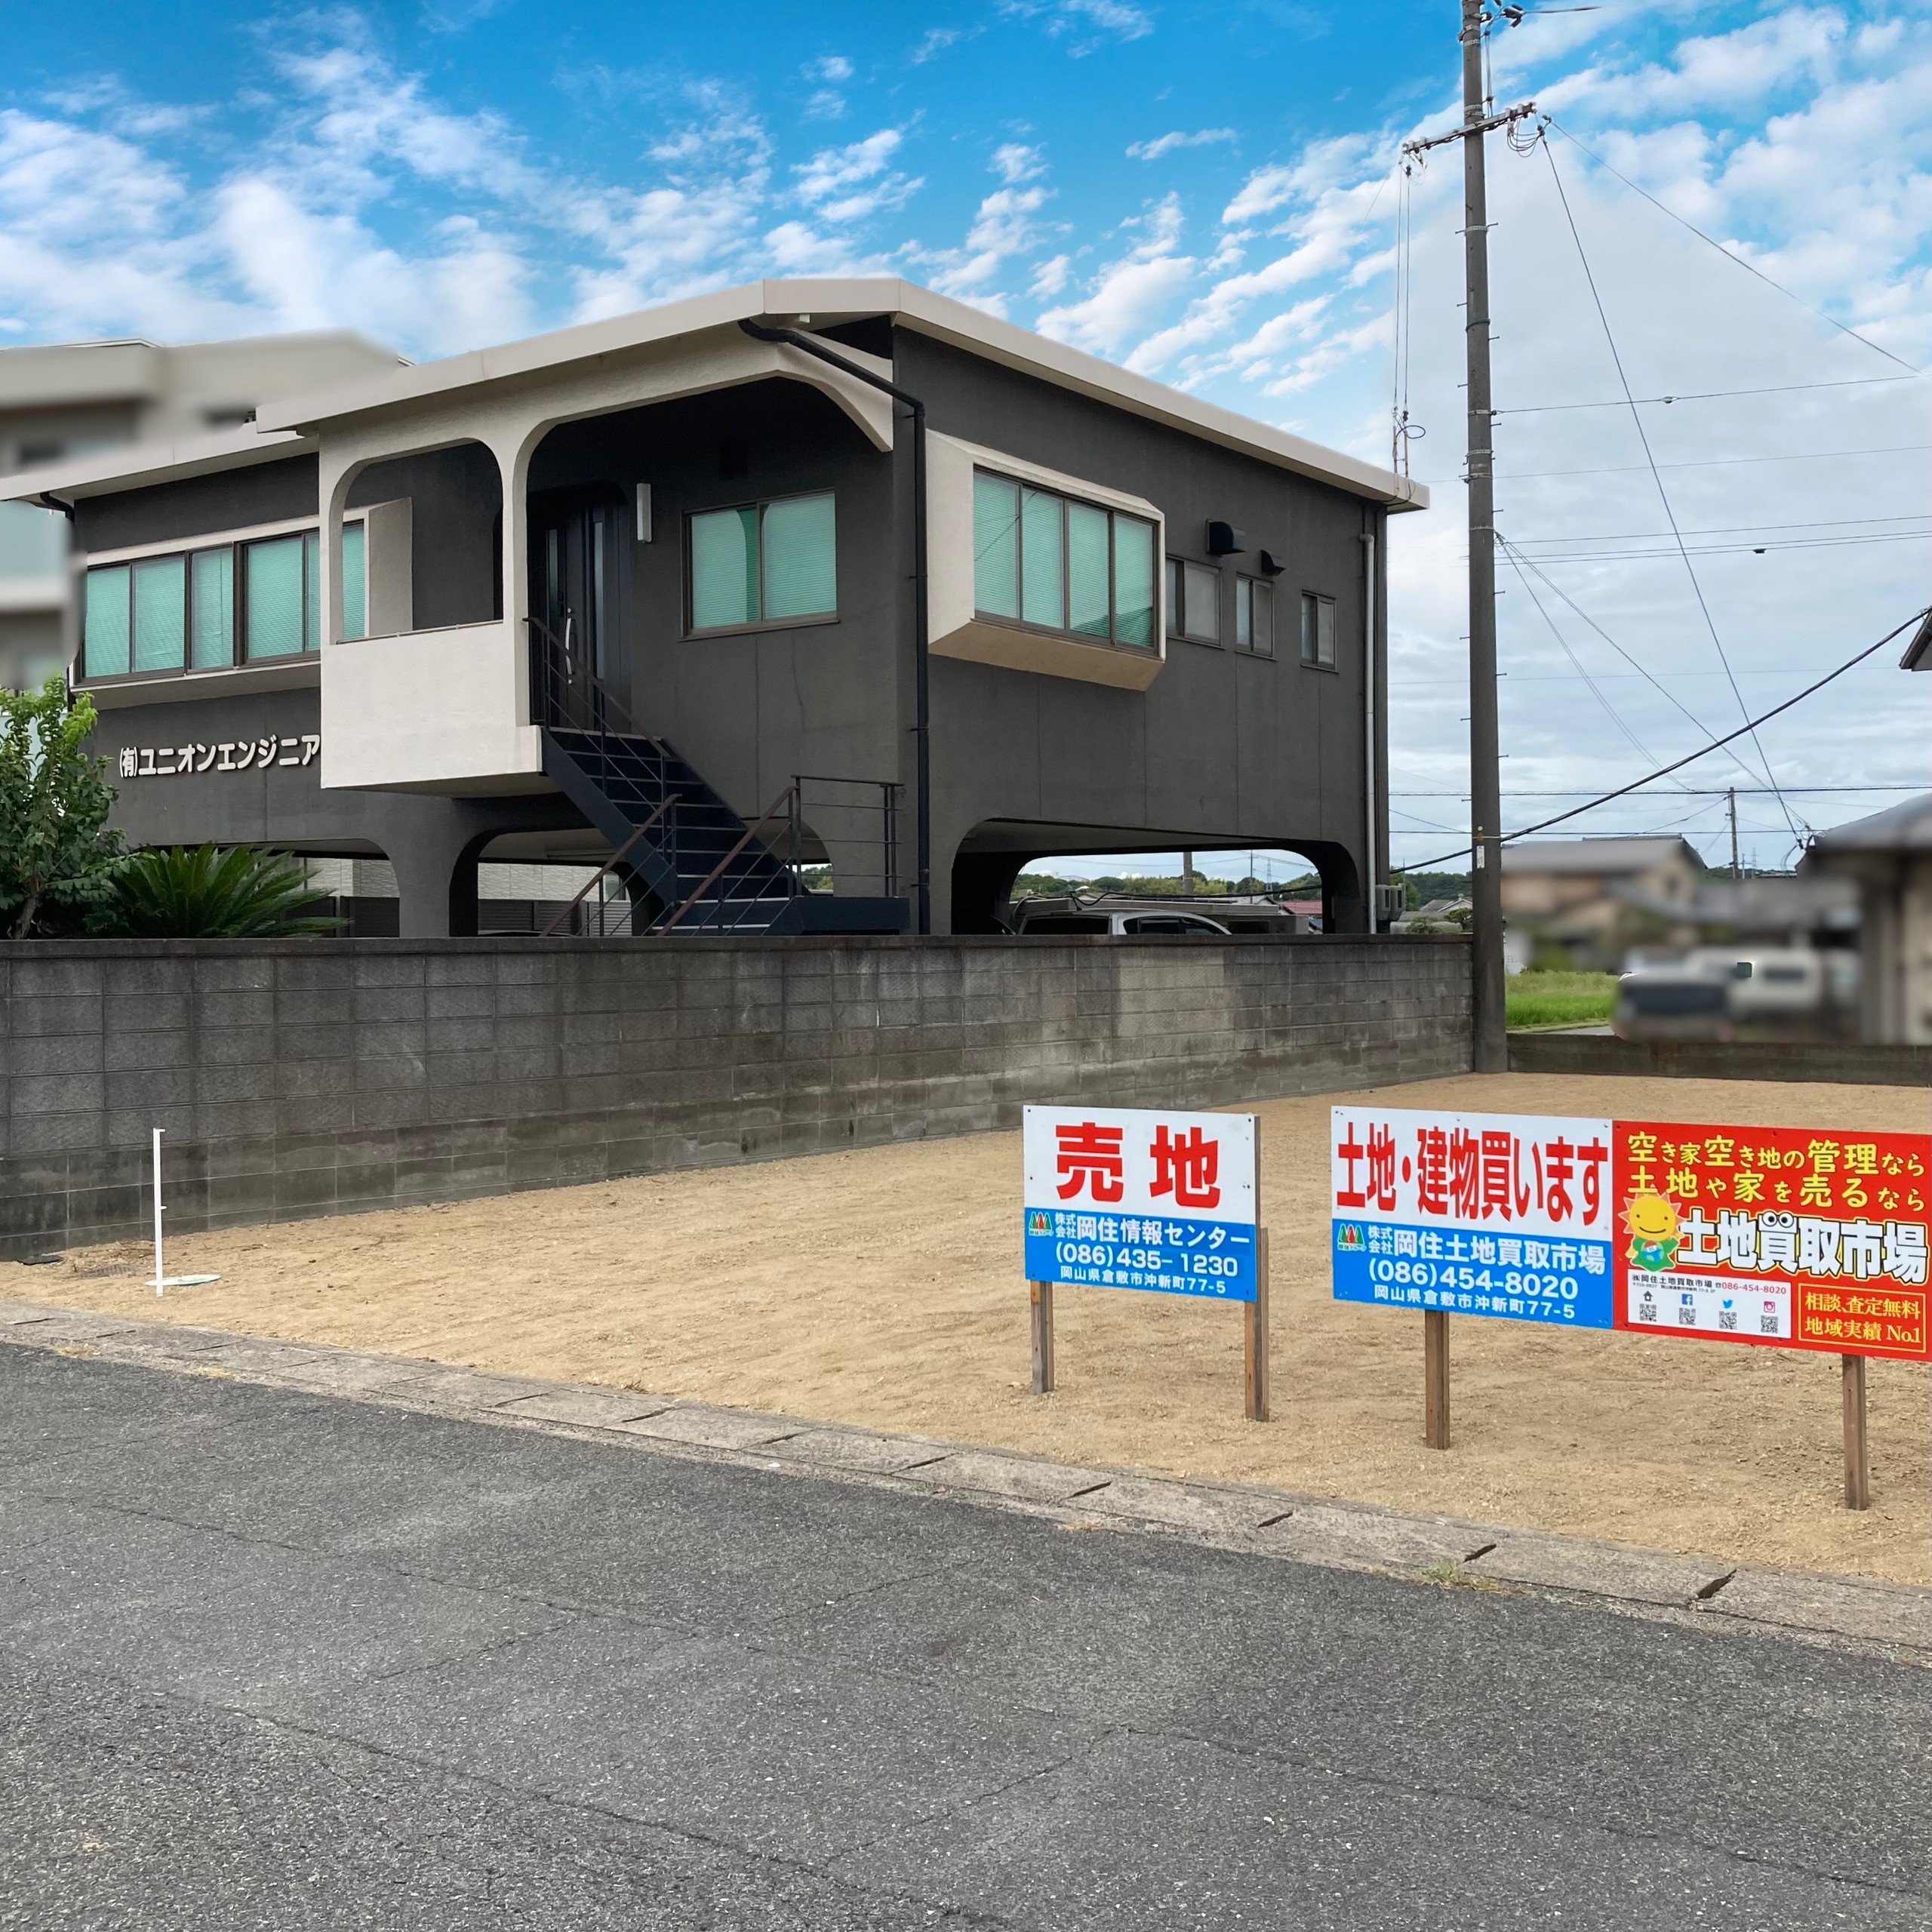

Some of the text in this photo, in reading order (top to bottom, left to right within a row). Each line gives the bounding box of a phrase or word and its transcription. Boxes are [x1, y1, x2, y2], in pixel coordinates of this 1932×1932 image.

[1055, 1121, 1221, 1209] 売地
[1337, 1121, 1608, 1226] 土地・建物買います
[1627, 1131, 1926, 1177] 空き家空き地の管理なら
[1627, 1165, 1926, 1212] 土地や家を売るなら
[1076, 1215, 1251, 1250] 岡住情報センター
[1393, 1229, 1606, 1275] 岡住土地買取市場
[1675, 1208, 1929, 1284] 土地買取市場
[1055, 1241, 1238, 1277] (086)435-1230
[1368, 1257, 1579, 1300] (086)454-8020
[1060, 1265, 1226, 1294] 岡山県倉敷市沖新町77-5
[1721, 1281, 1787, 1294] 086-454-8020
[1374, 1284, 1576, 1319] 岡山県倉敷市沖新町77-5
[1804, 1291, 1921, 1320] 相談、査定無料
[1804, 1315, 1921, 1343] 地域実績 No.1
